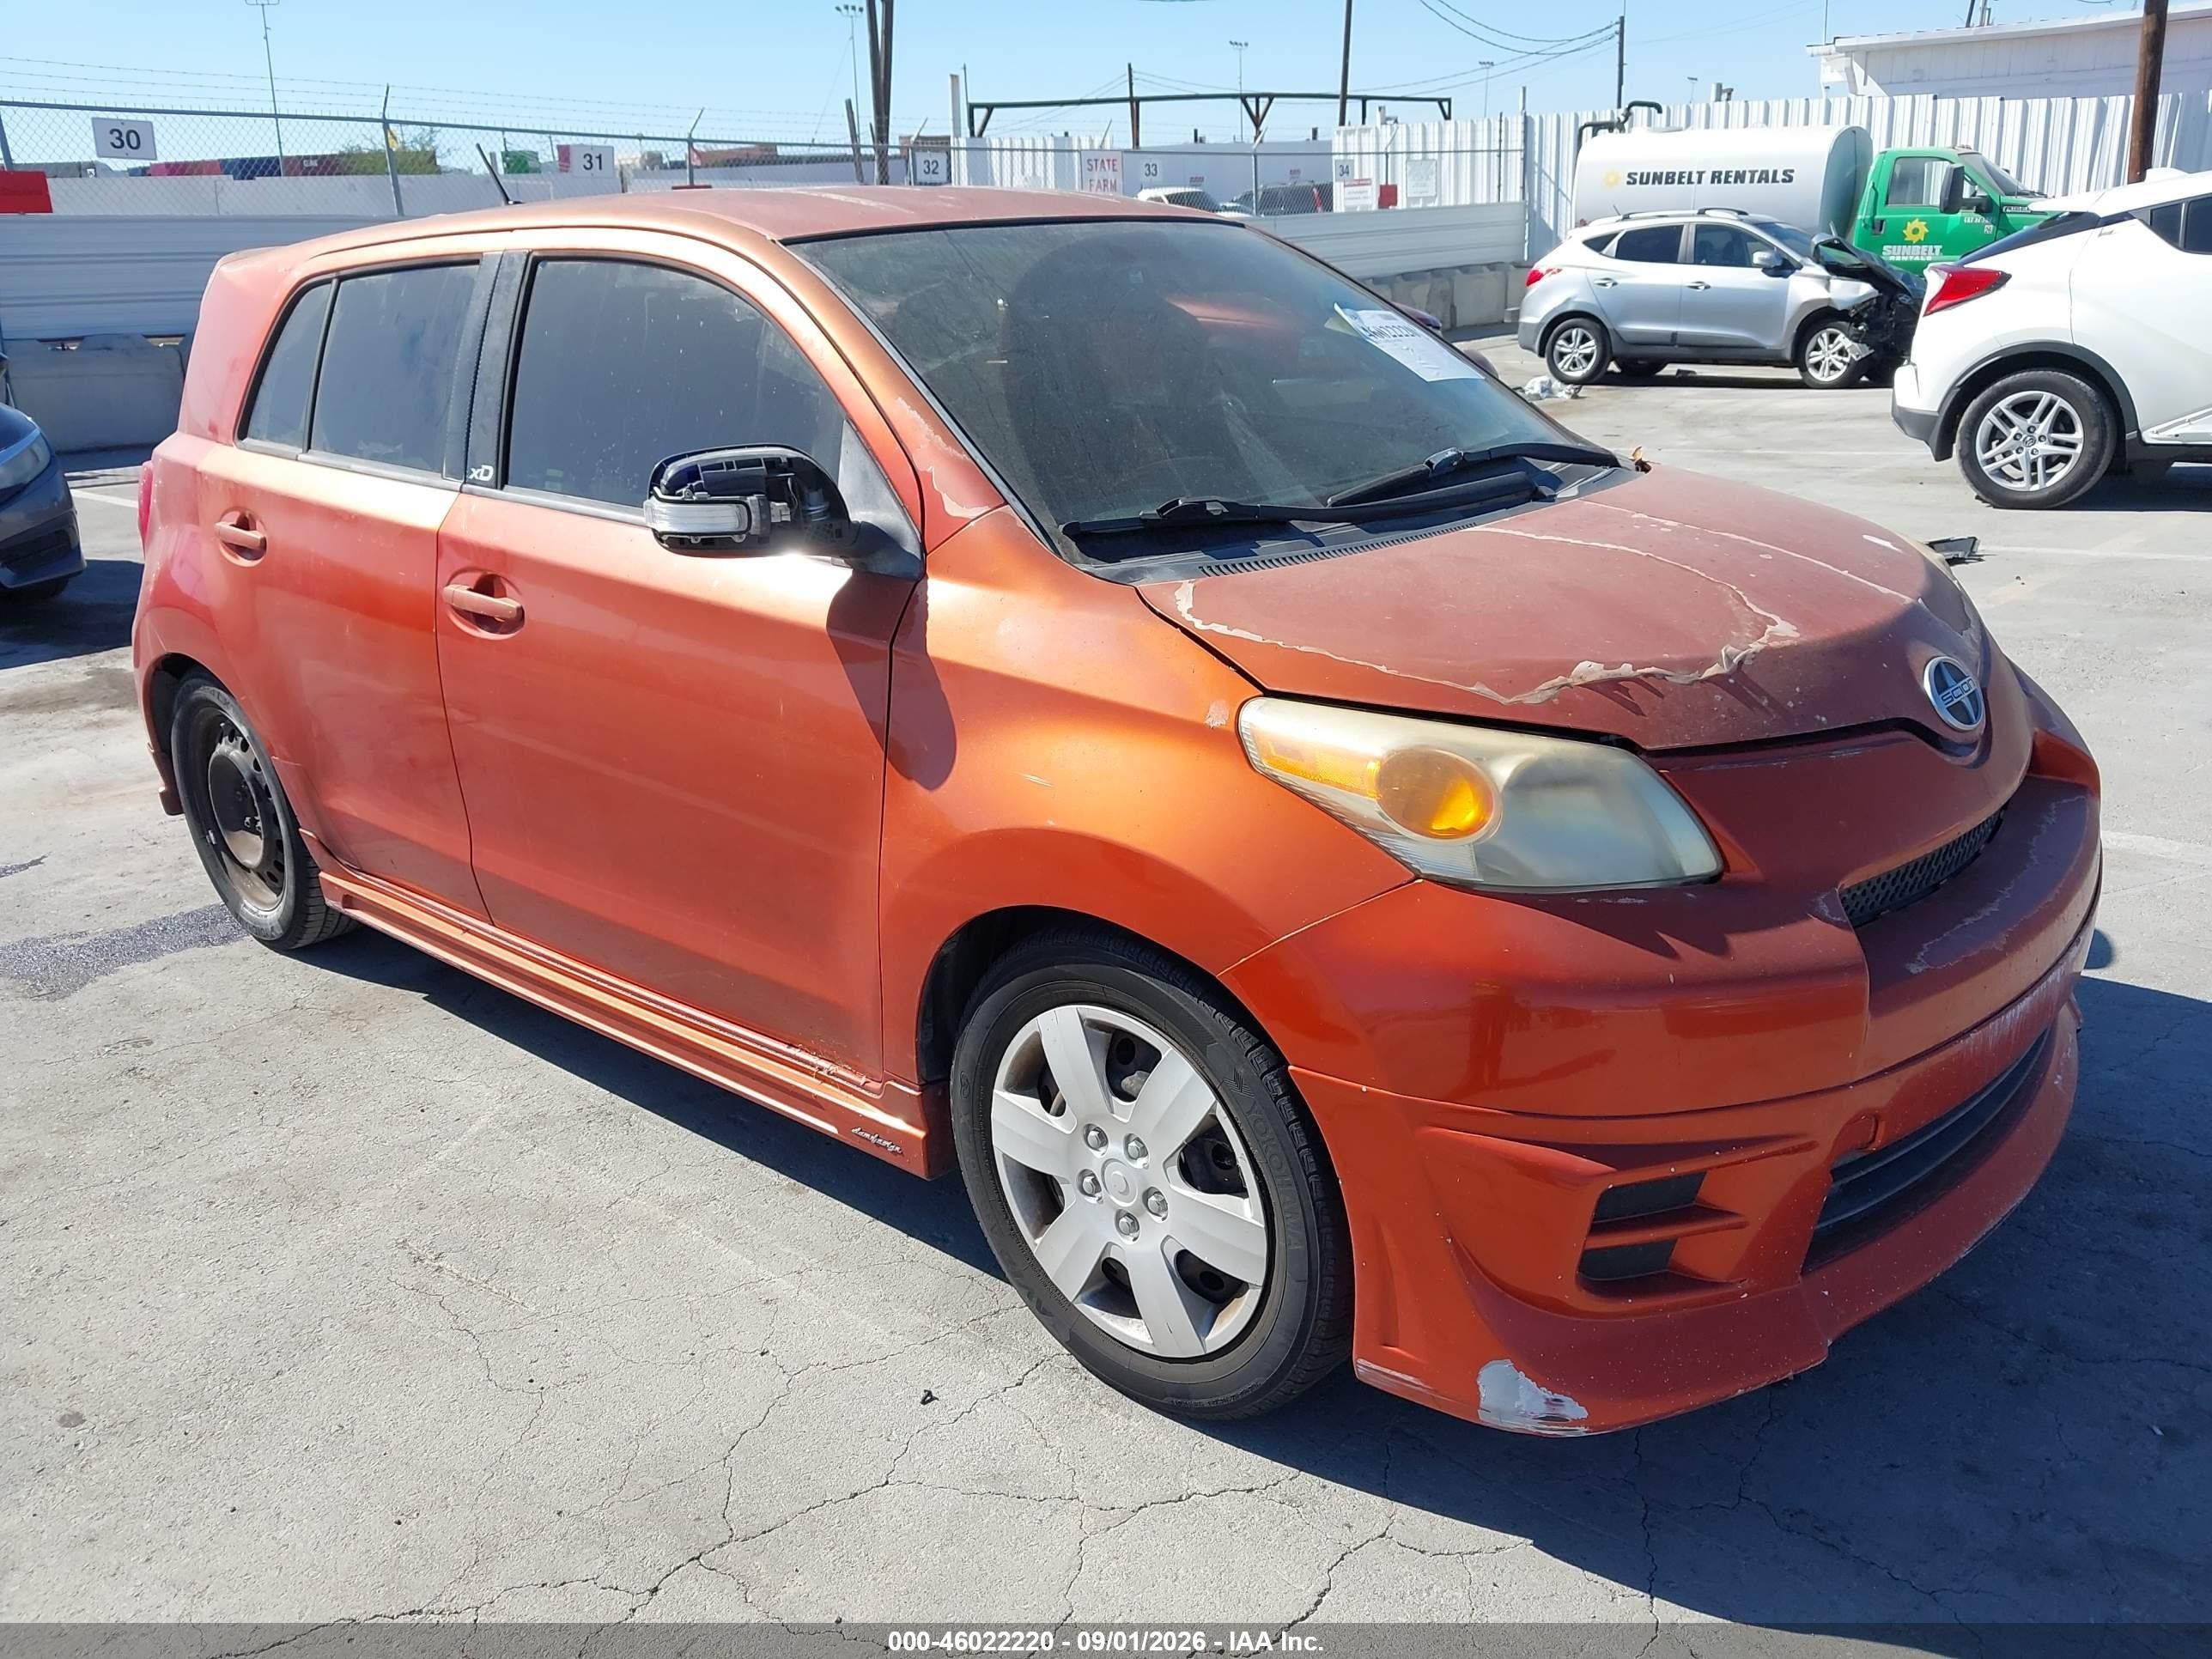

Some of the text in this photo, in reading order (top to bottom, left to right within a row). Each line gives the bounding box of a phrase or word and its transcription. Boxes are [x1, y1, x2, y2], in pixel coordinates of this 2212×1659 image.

[109, 128, 141, 150] 30
[583, 153, 603, 171] 31
[923, 160, 939, 175] 32
[1086, 158, 1119, 173] STATE
[1144, 163, 1158, 177] 33
[1340, 164, 1350, 177] 34
[1626, 168, 1796, 185] SUNBELT RENTALS
[1089, 179, 1118, 193] FARM
[1882, 245, 1943, 257] SUNBELT
[469, 464, 494, 481] xD
[1942, 678, 1975, 705] SCION
